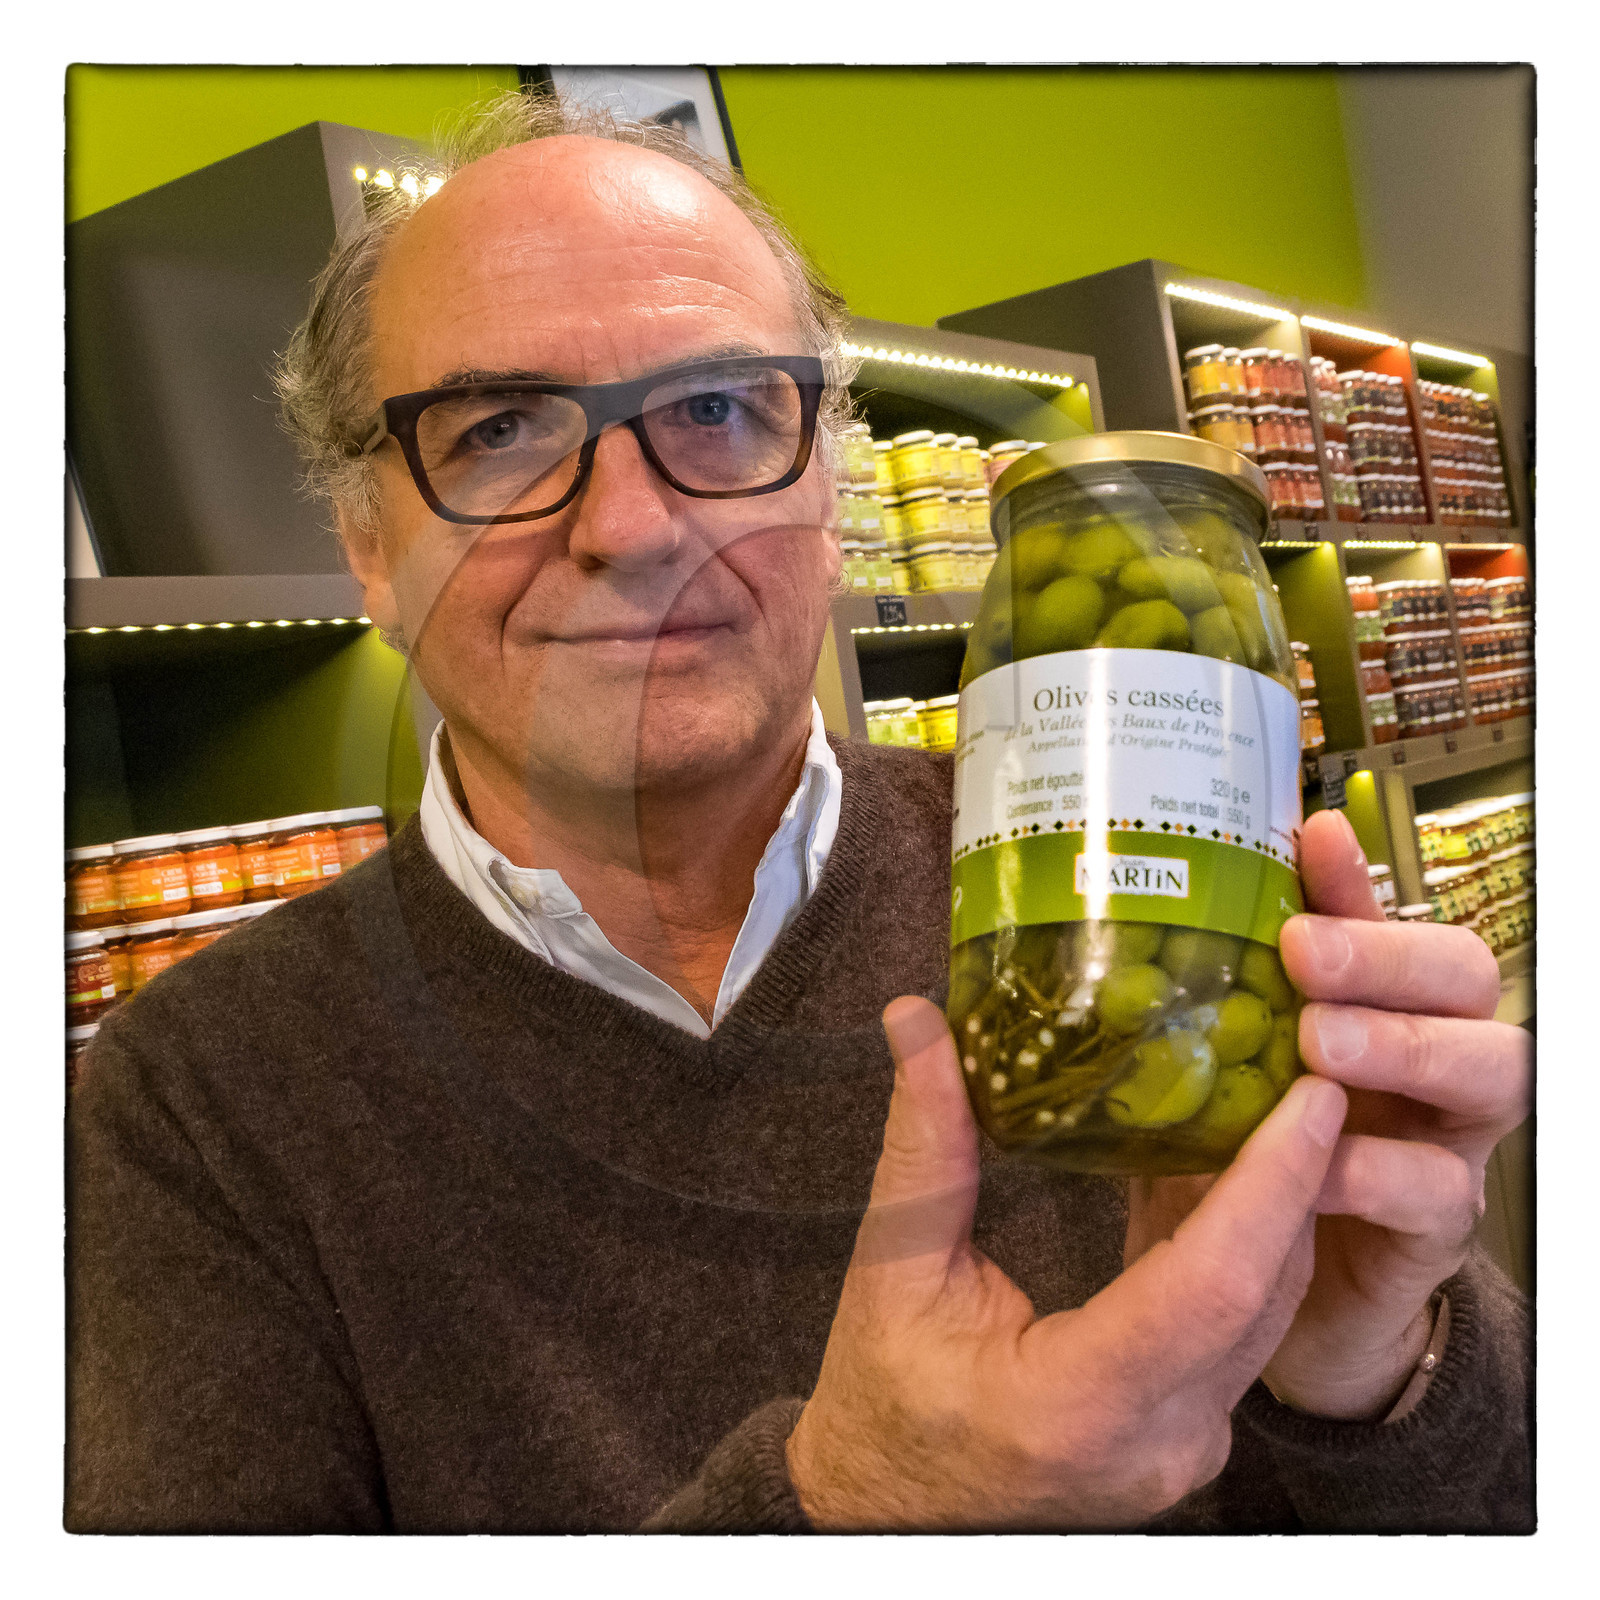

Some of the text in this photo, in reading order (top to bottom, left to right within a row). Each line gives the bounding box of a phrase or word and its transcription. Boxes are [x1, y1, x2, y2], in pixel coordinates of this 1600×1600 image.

[1033, 684, 1224, 717] Olivs cassées
[1123, 713, 1166, 730] Baux
[1170, 716, 1190, 733] de
[1194, 719, 1255, 748] Proence
[1029, 775, 1045, 791] net
[1210, 777, 1230, 798] 320
[1232, 786, 1240, 805] g
[1150, 794, 1180, 813] Poids
[1180, 800, 1197, 815] net
